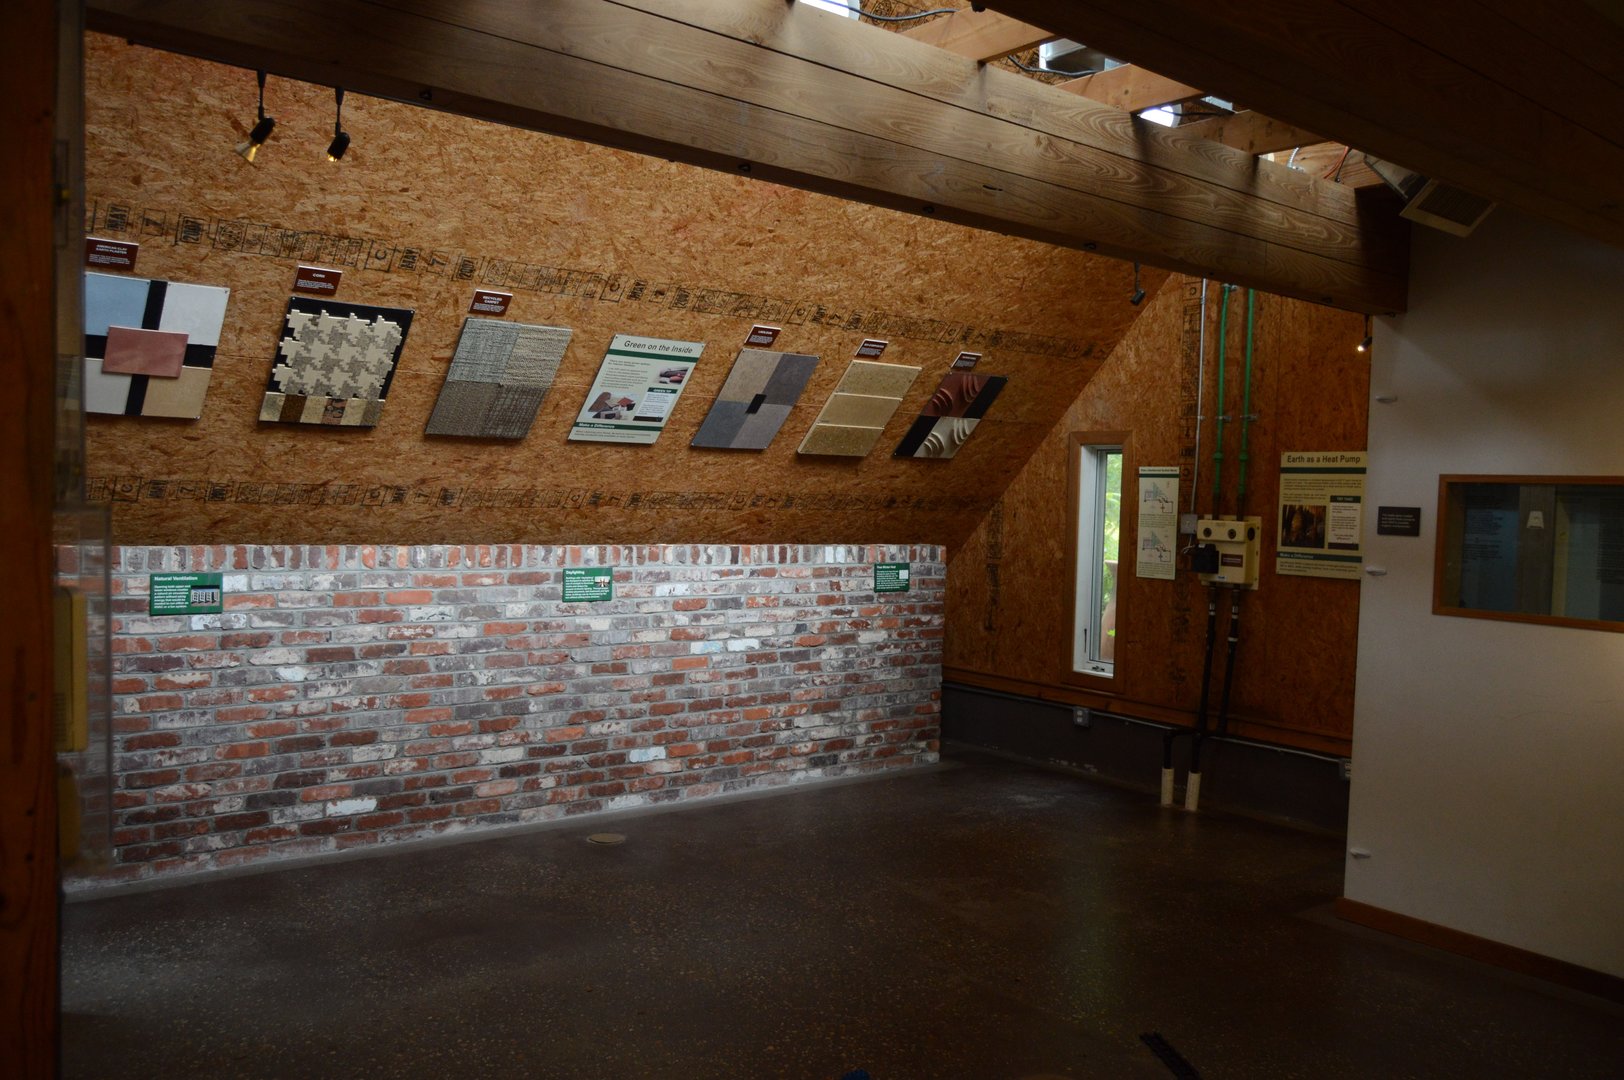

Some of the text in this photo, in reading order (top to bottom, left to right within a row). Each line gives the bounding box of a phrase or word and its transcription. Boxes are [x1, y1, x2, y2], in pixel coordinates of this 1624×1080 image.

[400, 248, 419, 270] MAY
[623, 340, 647, 350] Green
[658, 344, 671, 353] the
[671, 345, 693, 354] Inside
[1287, 455, 1305, 463] Earth
[1322, 455, 1338, 463] Heat
[1340, 454, 1361, 465] Pump
